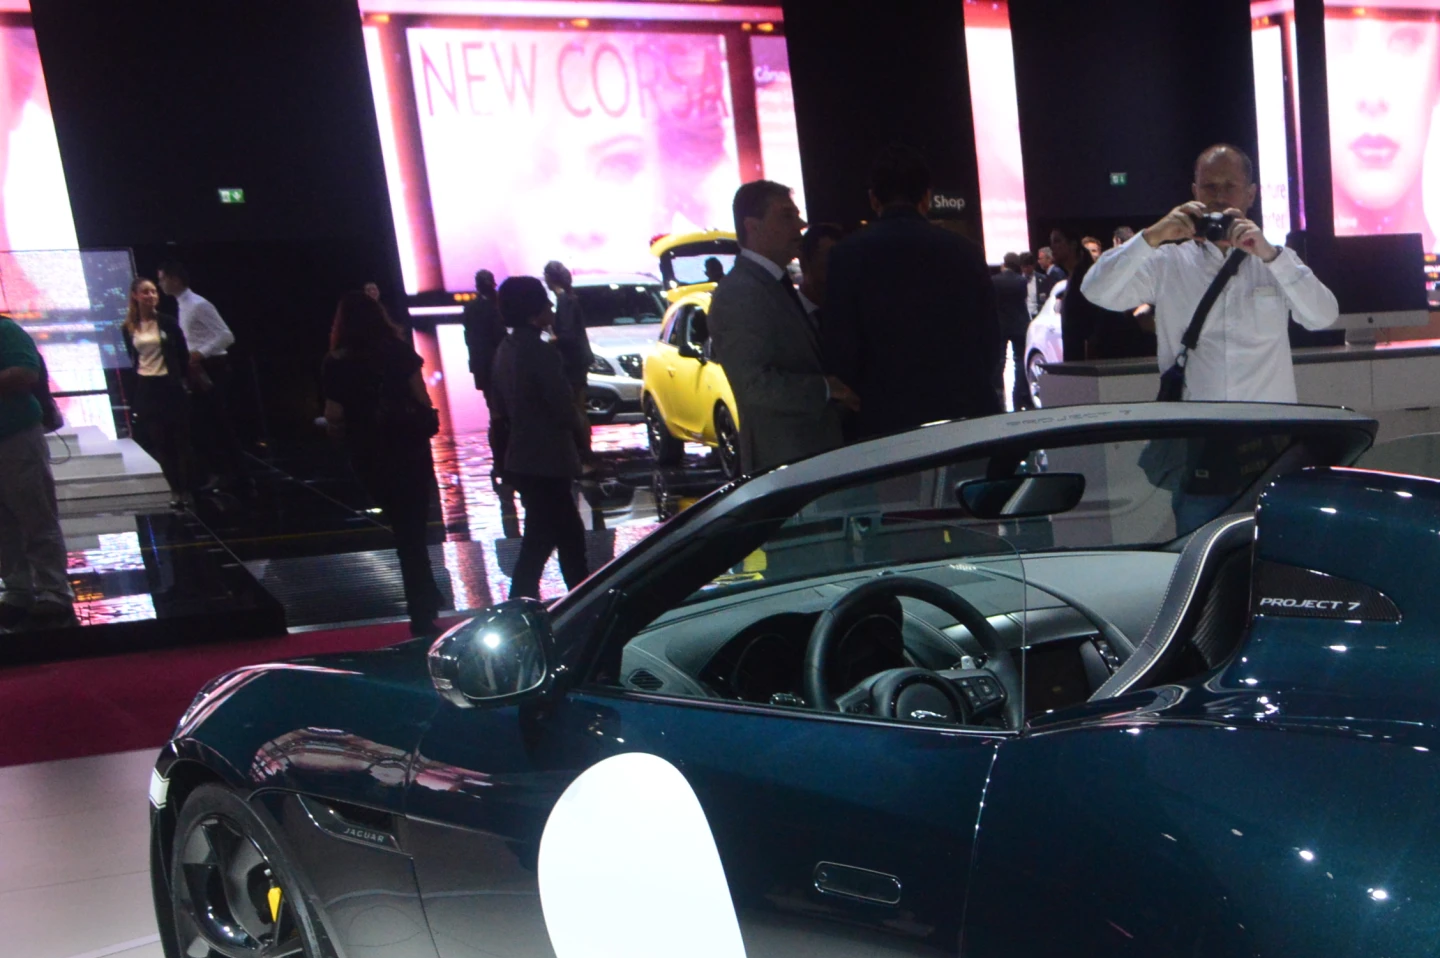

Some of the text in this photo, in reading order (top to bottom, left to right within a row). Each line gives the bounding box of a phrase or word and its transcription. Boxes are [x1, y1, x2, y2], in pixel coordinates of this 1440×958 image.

[419, 40, 538, 118] NEW
[555, 40, 730, 119] CORSA
[933, 195, 966, 211] Shop
[1260, 597, 1361, 611] PROJECT 7
[343, 827, 385, 843] JAGUAR
